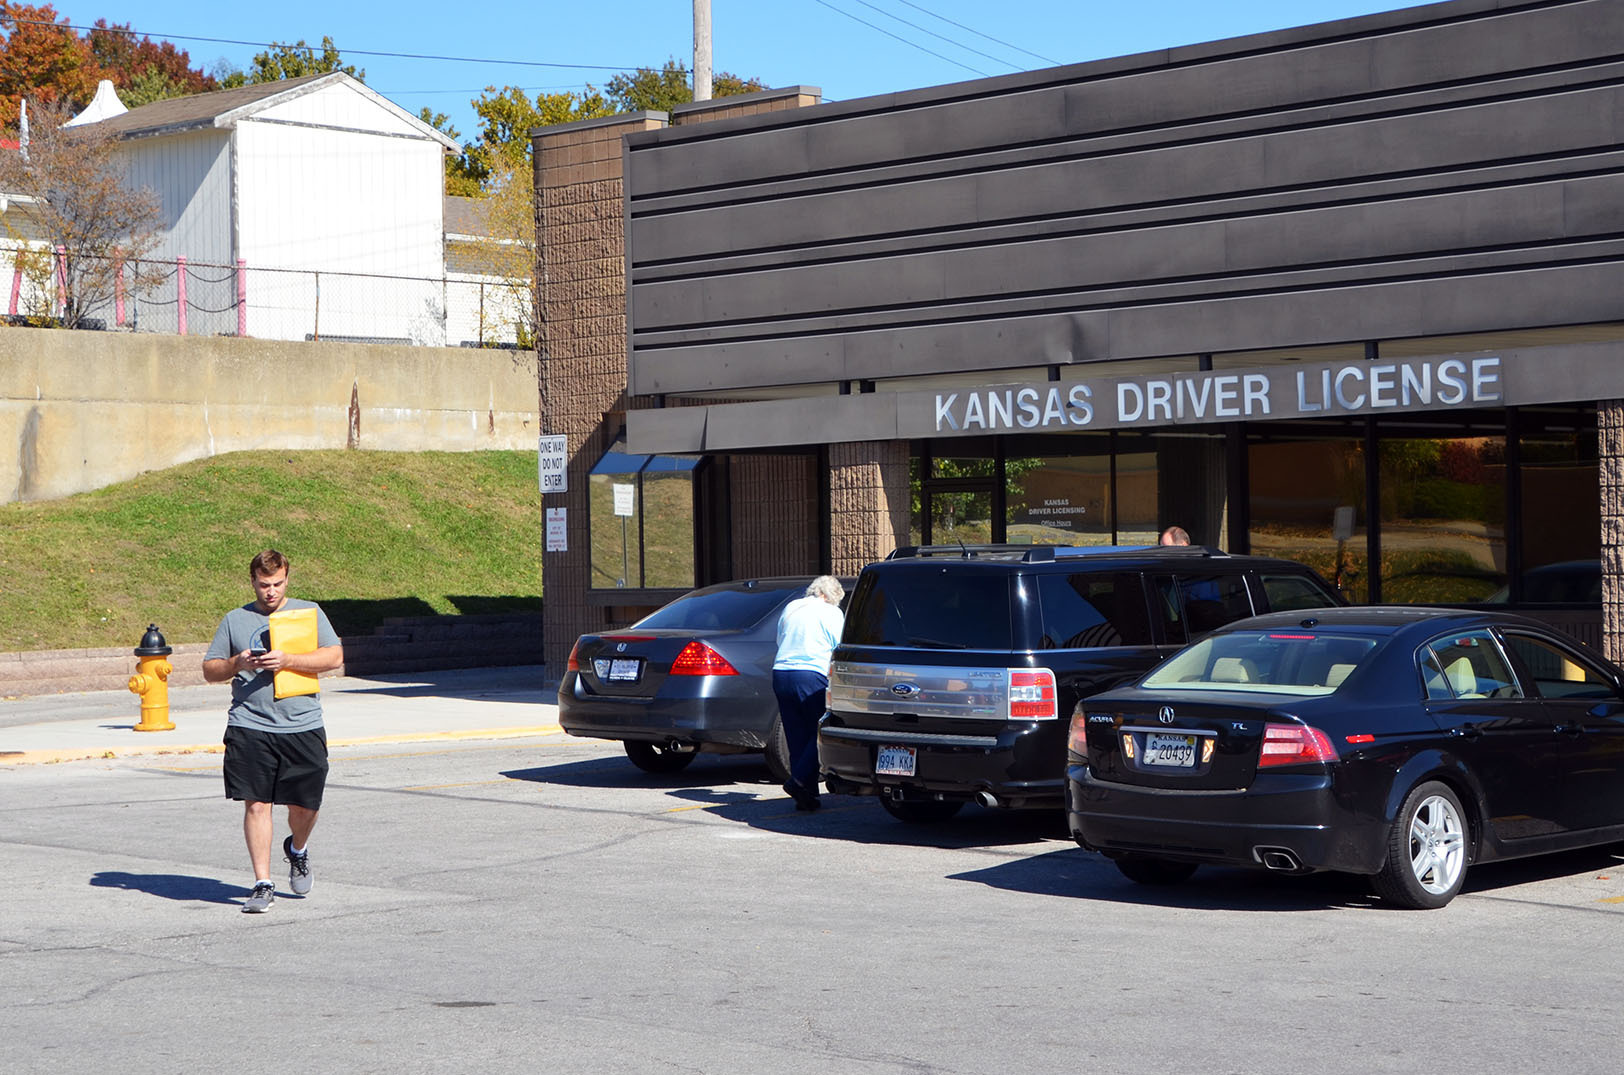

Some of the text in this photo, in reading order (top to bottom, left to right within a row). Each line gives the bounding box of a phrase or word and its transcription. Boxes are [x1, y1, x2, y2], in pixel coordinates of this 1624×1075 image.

[935, 356, 1502, 432] KANSAS DRIVER LICENSE
[540, 441, 565, 454] ONE WAY
[543, 458, 563, 470] DO NOT
[544, 474, 562, 487] ENTER
[1088, 715, 1114, 723] ACURA
[1232, 722, 1248, 730] TL
[1157, 734, 1186, 742] KANSAS
[1159, 744, 1192, 761] 20439
[899, 755, 913, 769] KKA
